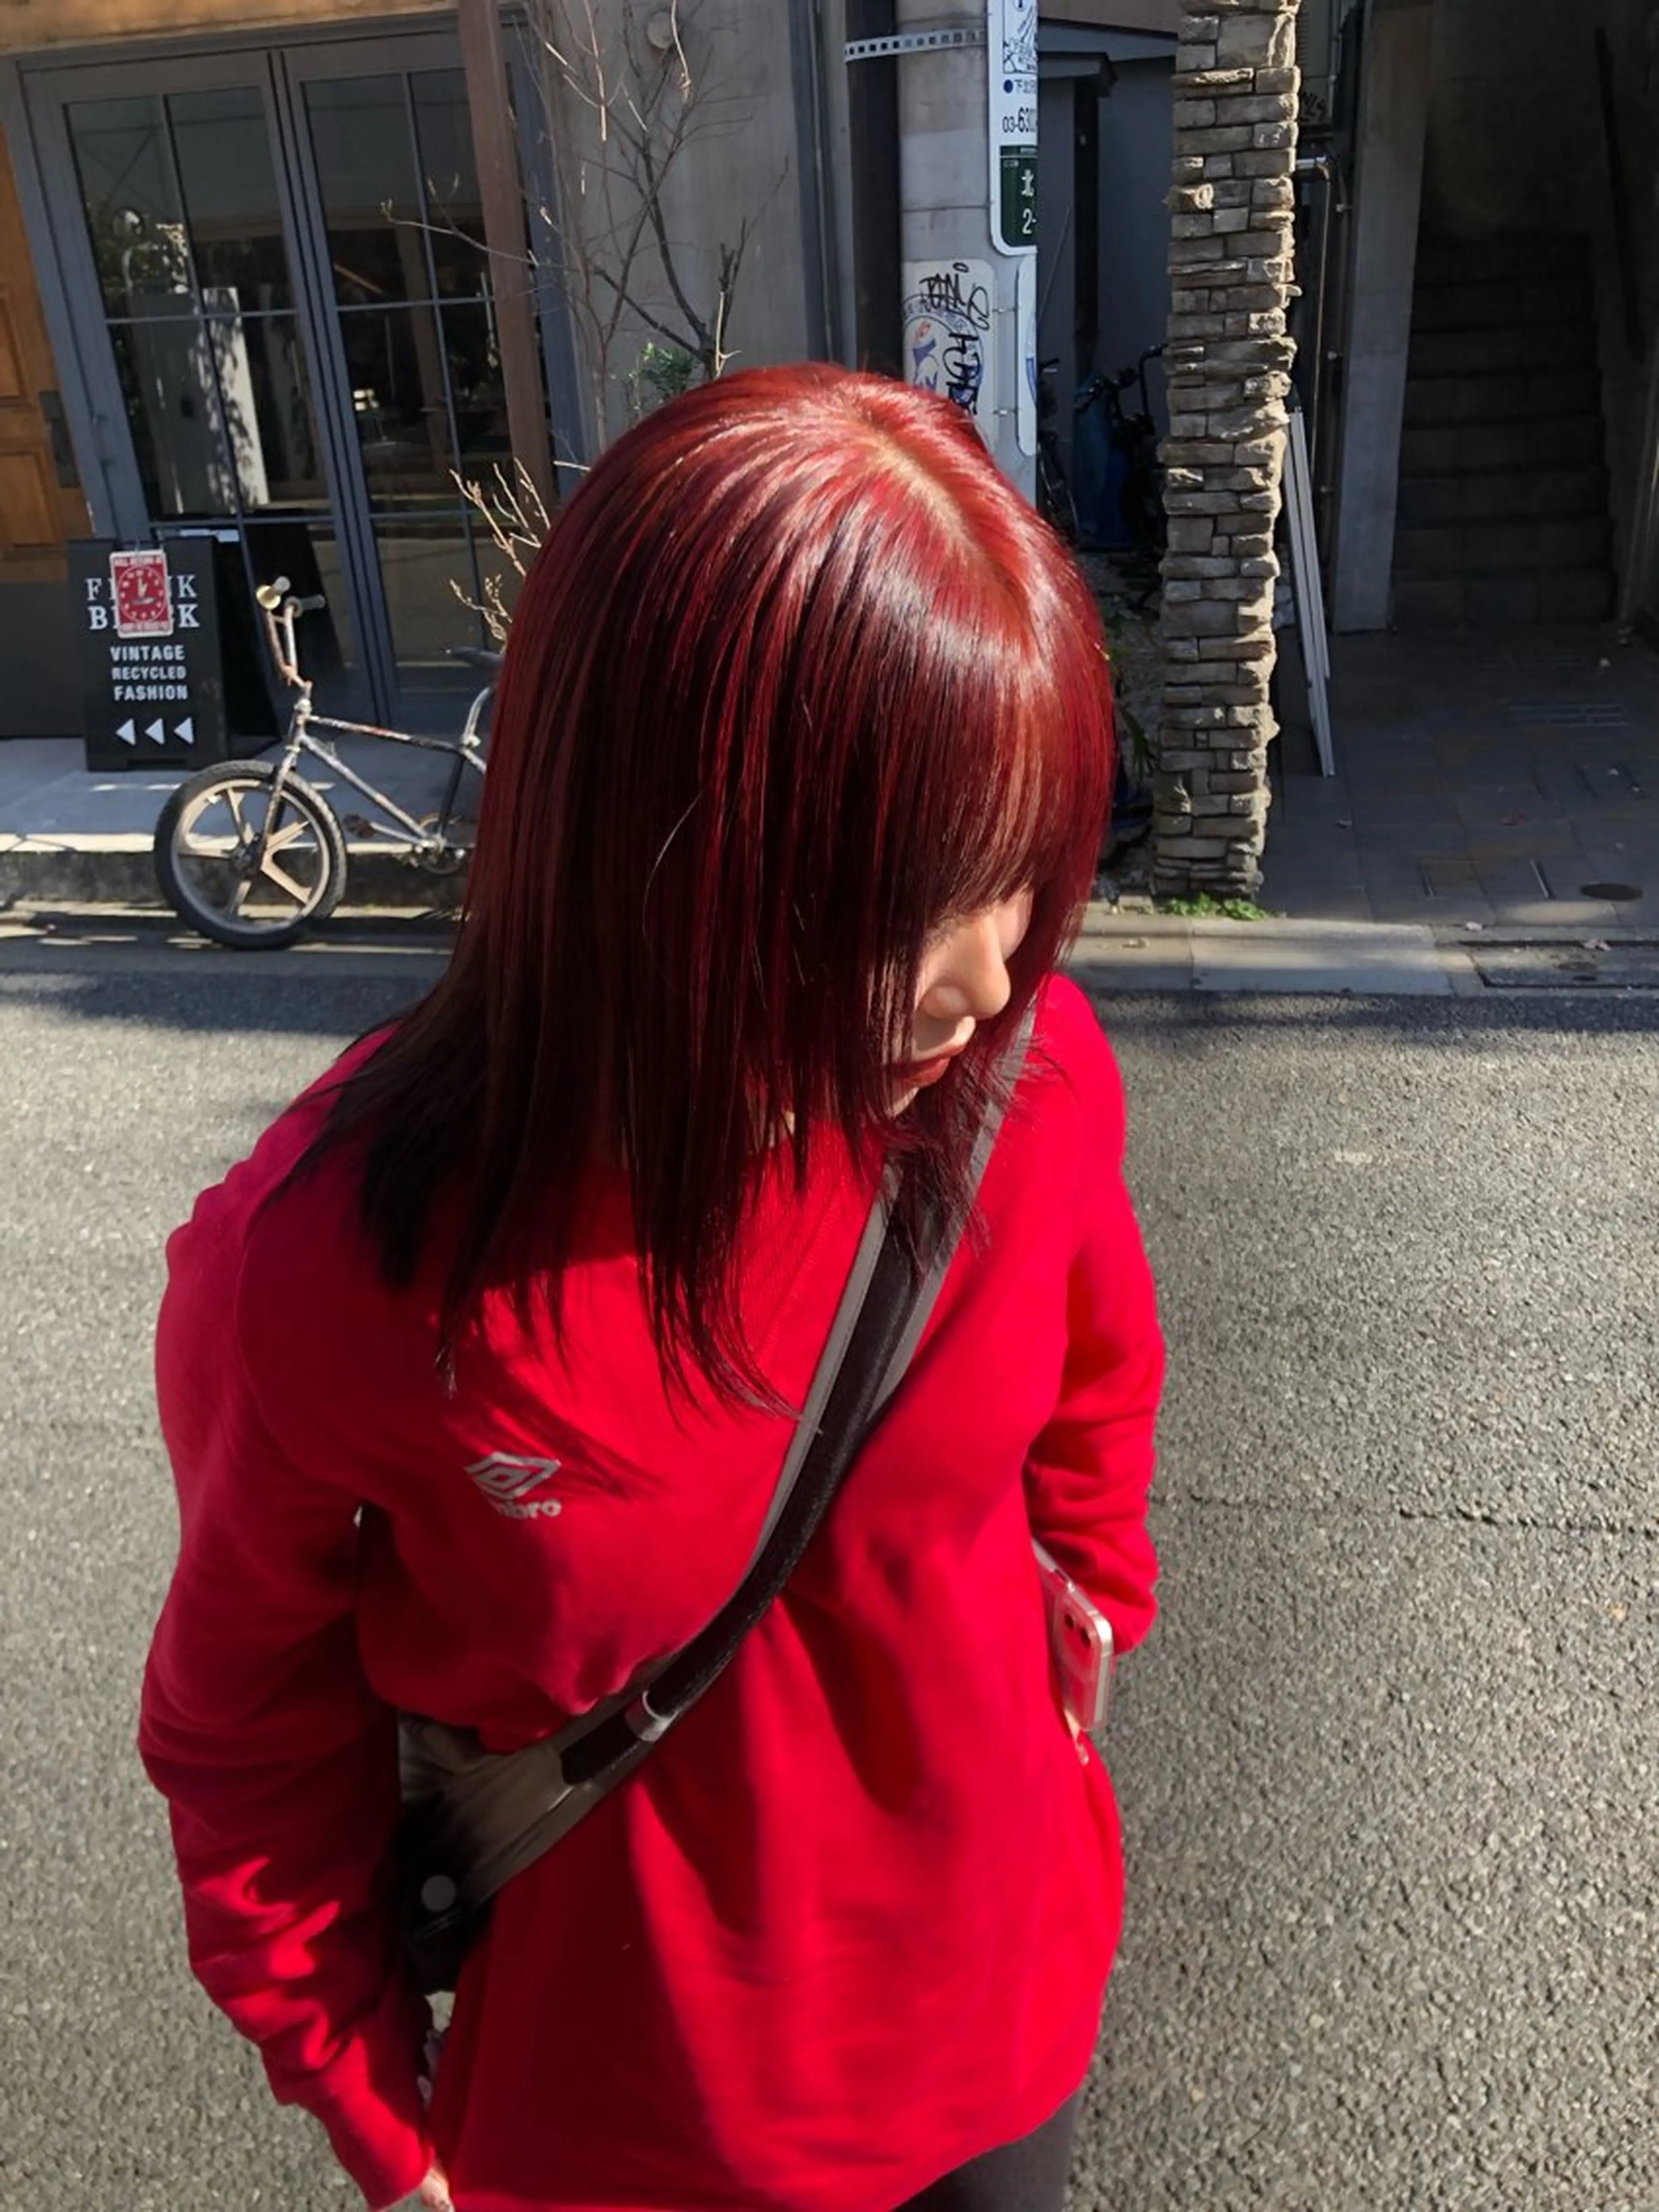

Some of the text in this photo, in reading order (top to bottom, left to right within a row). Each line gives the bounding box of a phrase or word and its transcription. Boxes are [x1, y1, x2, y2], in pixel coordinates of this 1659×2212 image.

[110, 645, 185, 661] VINTAGE
[111, 666, 186, 680] RECYCLED
[114, 685, 188, 701] FASHION
